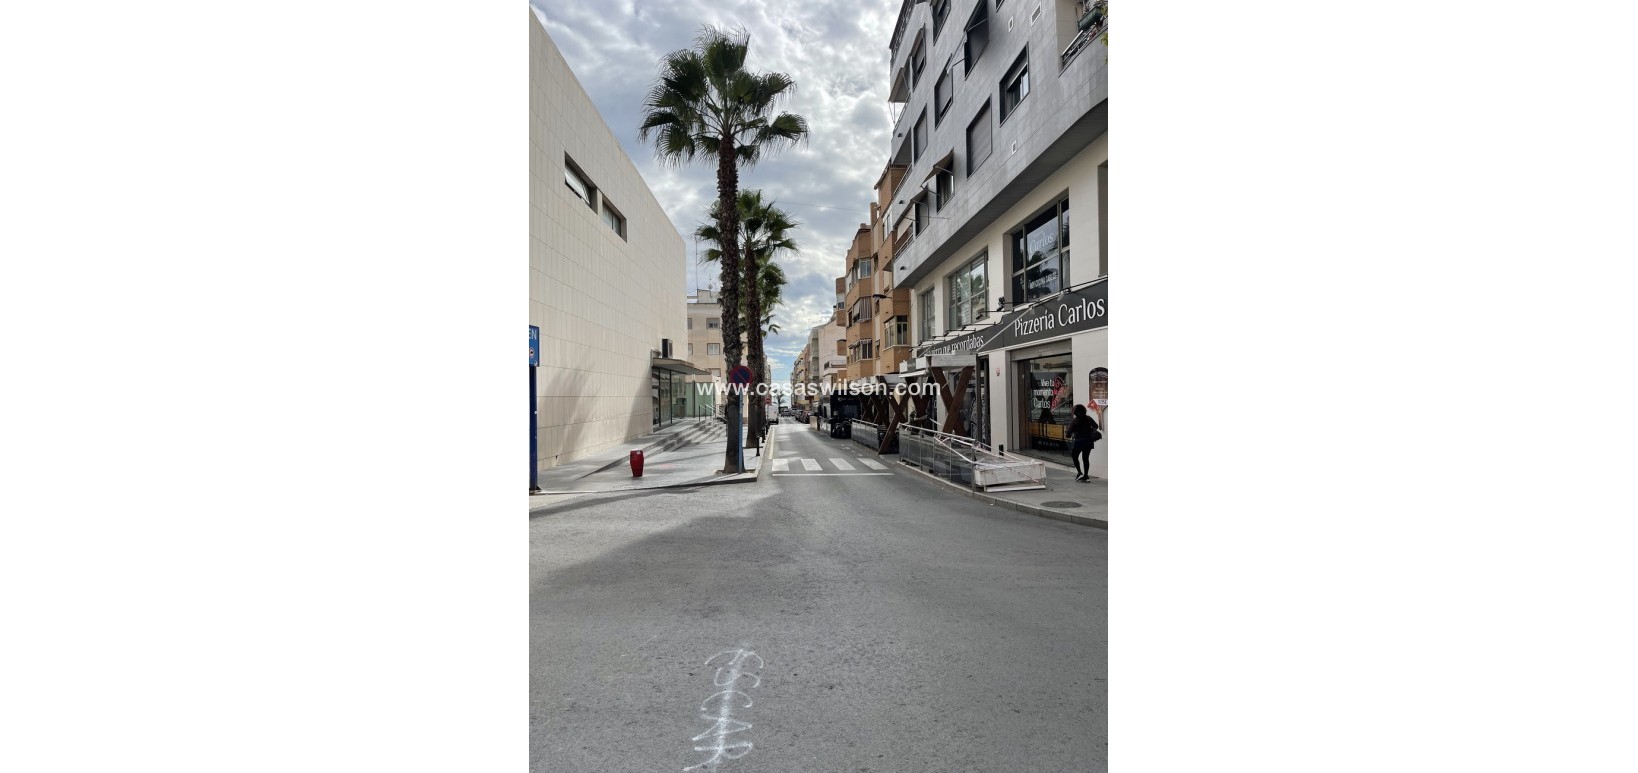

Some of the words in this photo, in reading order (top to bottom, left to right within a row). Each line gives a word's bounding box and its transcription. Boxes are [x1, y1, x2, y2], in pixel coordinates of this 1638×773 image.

[1014, 309, 1055, 338] Pizzería
[1058, 298, 1105, 327] Carlos
[1033, 388, 1053, 396] momento
[1033, 397, 1051, 409] Carlos
